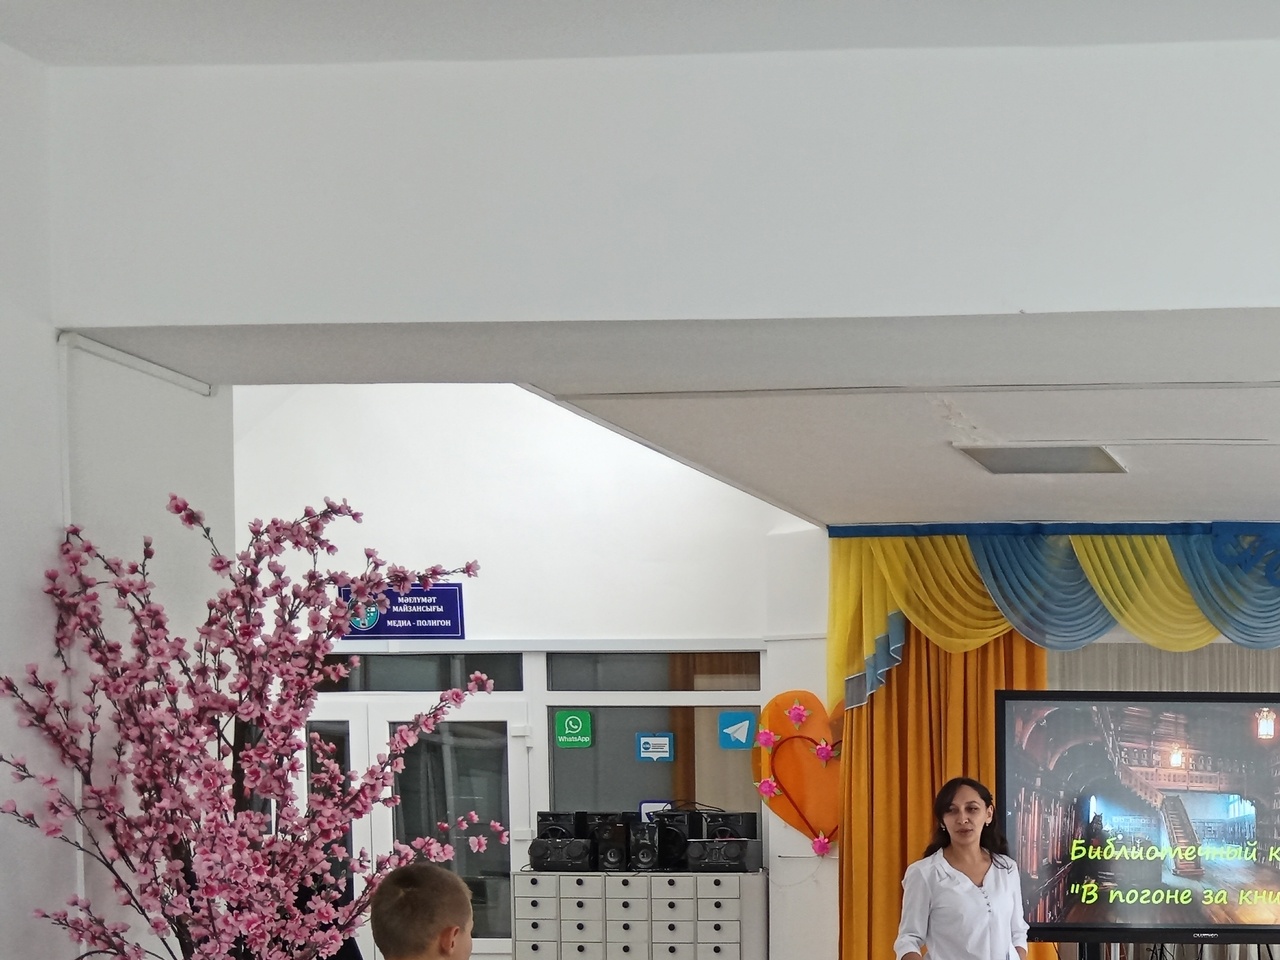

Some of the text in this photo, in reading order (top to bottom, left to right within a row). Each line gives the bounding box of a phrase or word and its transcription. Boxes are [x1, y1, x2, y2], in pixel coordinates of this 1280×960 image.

[386, 619, 412, 627] МЕДИА
[416, 619, 451, 627] ПОЛИГОН
[558, 735, 590, 743] WhatsApp
[1070, 836, 1258, 862] Библиотечный
[1070, 883, 1099, 904] "В
[1108, 888, 1193, 905] погоне
[1201, 888, 1228, 905] за
